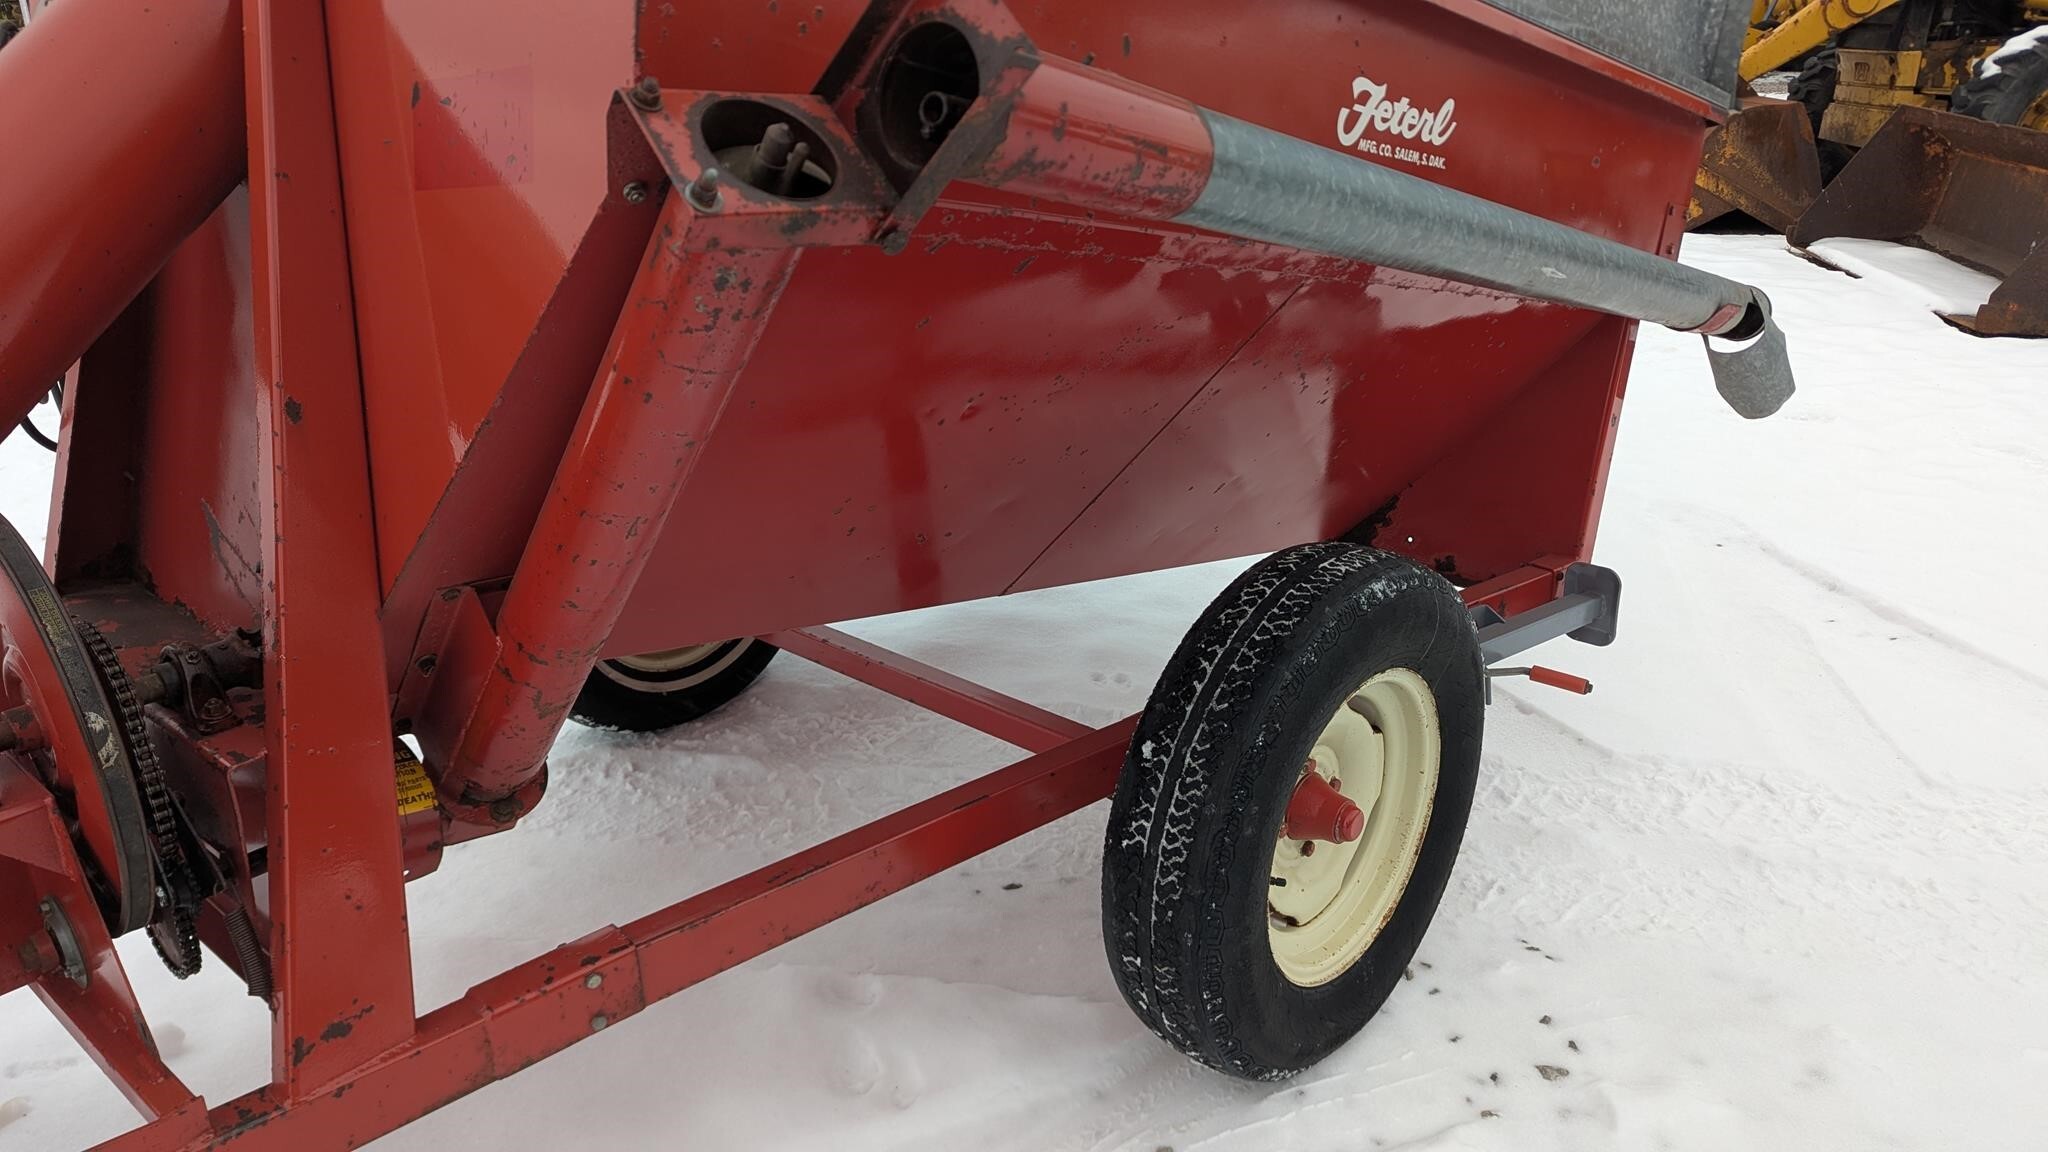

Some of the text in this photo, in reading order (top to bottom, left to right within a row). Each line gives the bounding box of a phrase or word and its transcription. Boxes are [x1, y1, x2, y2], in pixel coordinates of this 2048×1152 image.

[1337, 76, 1457, 146] Feterl
[1357, 138, 1446, 169] MFG. CO. SALEM, S. DAK.
